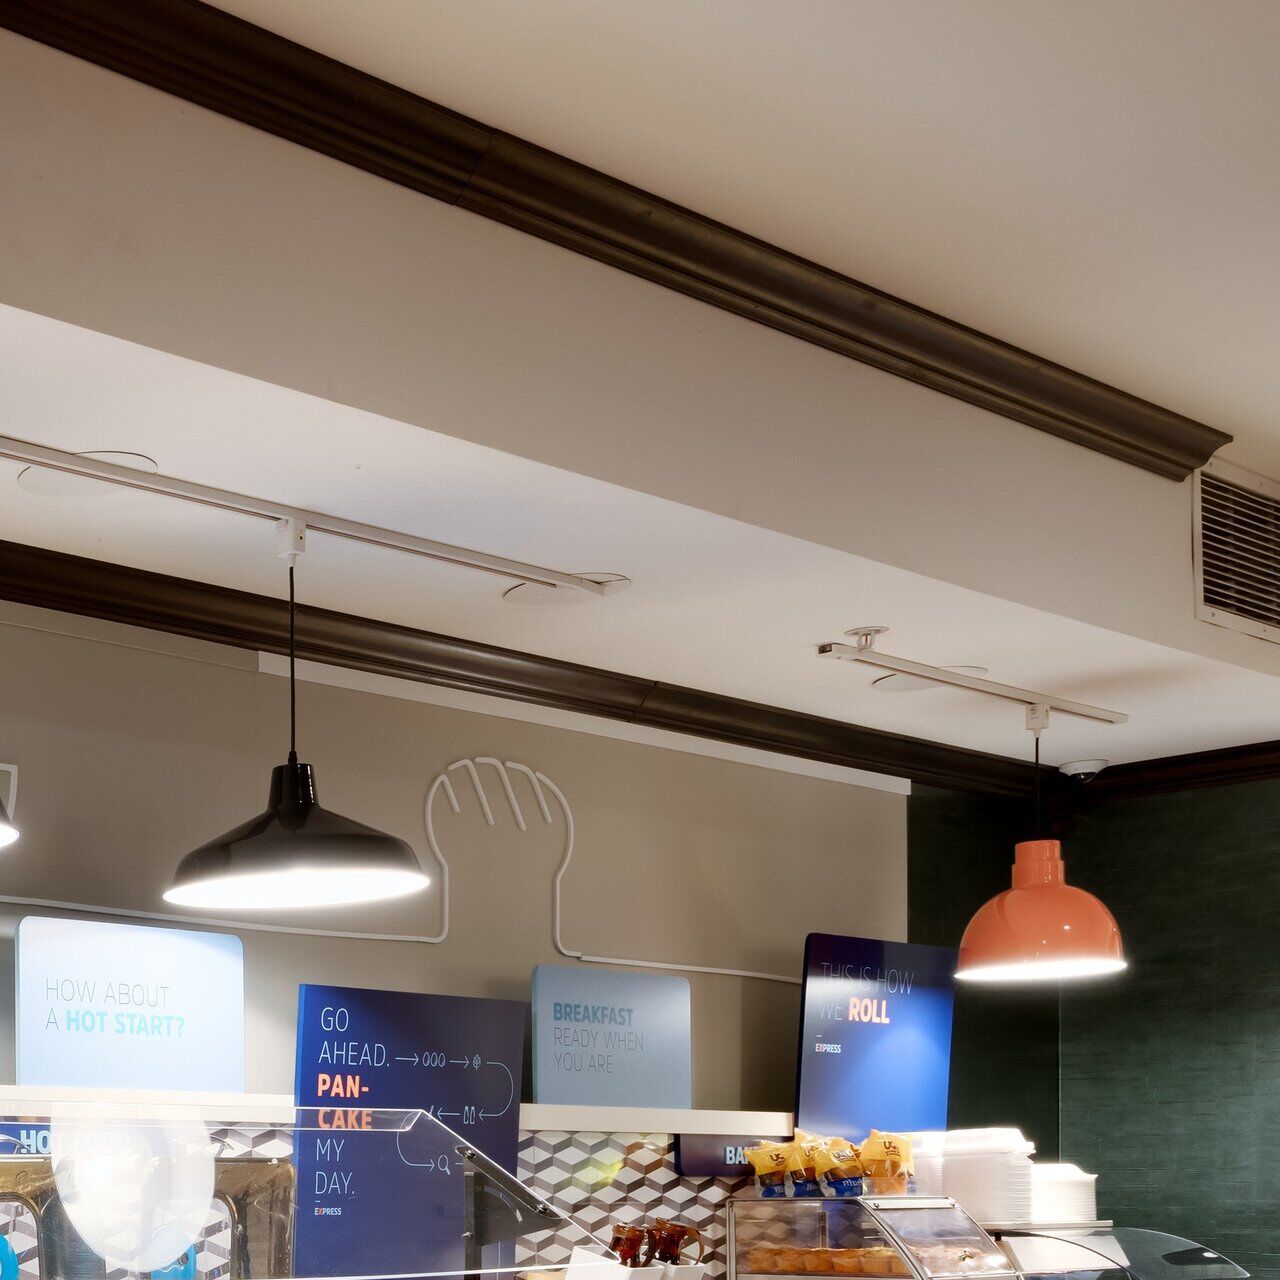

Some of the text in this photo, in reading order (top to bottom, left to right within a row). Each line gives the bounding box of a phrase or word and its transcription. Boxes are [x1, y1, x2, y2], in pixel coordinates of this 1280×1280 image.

[821, 962, 915, 995] THIS IS HOW
[45, 977, 170, 1008] HOW ABOUT
[45, 1007, 185, 1038] A HOT START?
[320, 1006, 350, 1032] GO
[553, 1002, 634, 1026] BREAKFAST
[818, 996, 890, 1025] WE ROLL
[553, 1027, 644, 1052] READY WHEN
[815, 1043, 842, 1054] EXPRESS
[318, 1040, 390, 1068] AHEAD.
[553, 1052, 614, 1074] YOU ARE
[317, 1073, 370, 1099] PAN-
[317, 1108, 373, 1131] CAKE
[315, 1138, 345, 1162] MY
[314, 1170, 356, 1196] DAY.
[314, 1207, 342, 1216] EXPRESS
